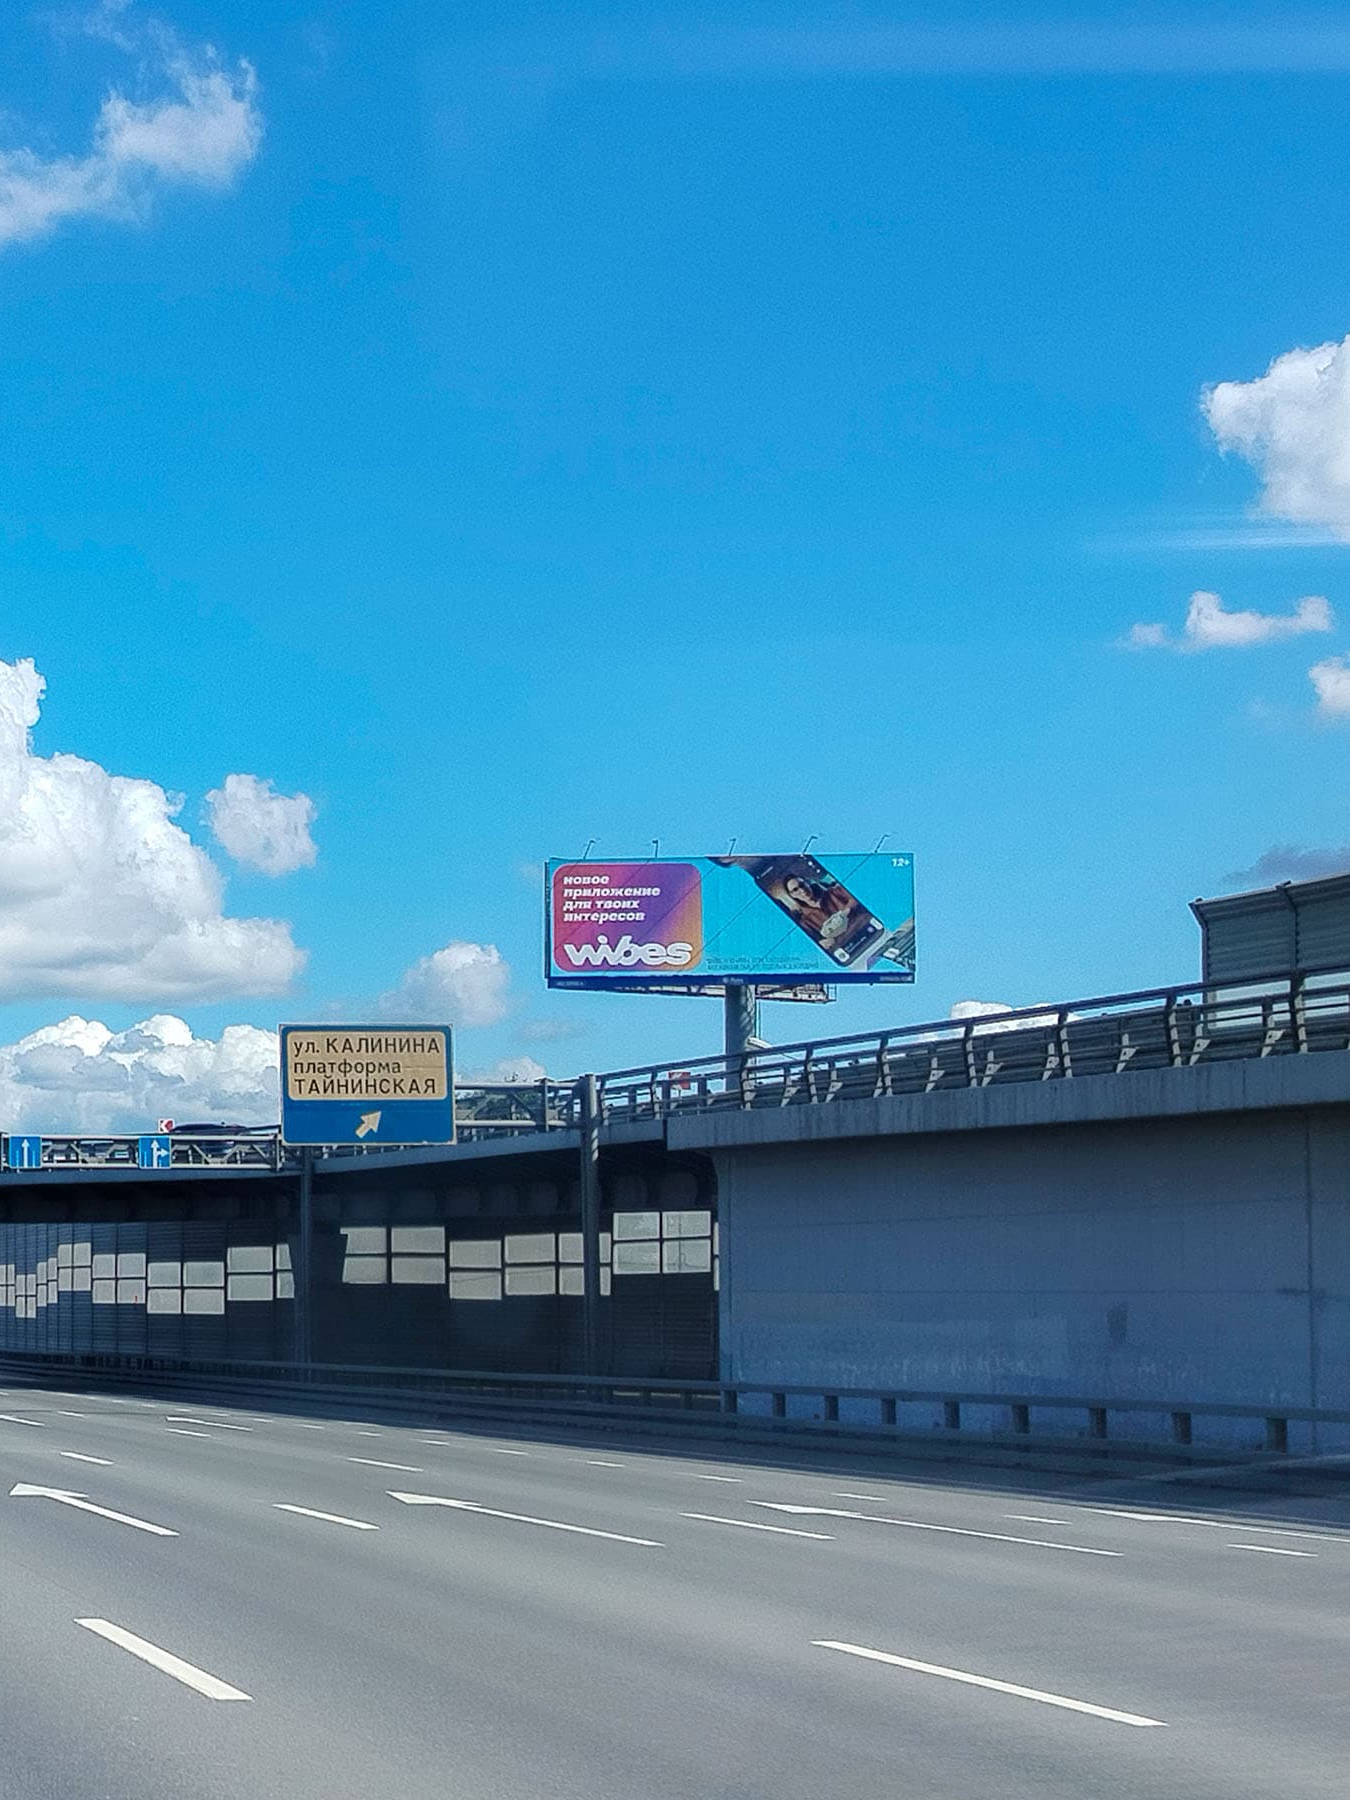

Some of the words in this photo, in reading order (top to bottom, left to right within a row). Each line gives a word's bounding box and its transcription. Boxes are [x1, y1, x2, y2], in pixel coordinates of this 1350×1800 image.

[891, 858, 910, 867] 12+
[563, 876, 610, 885] новое
[563, 887, 661, 899] приложение
[563, 900, 592, 911] для
[595, 900, 640, 909] твоих
[563, 912, 645, 924] интересов
[293, 1041, 320, 1057] ул.
[326, 1037, 440, 1053] КАЛИНИНА
[293, 1059, 401, 1077] платформа
[294, 1073, 436, 1094] ТАЙНИНСКАЯ
